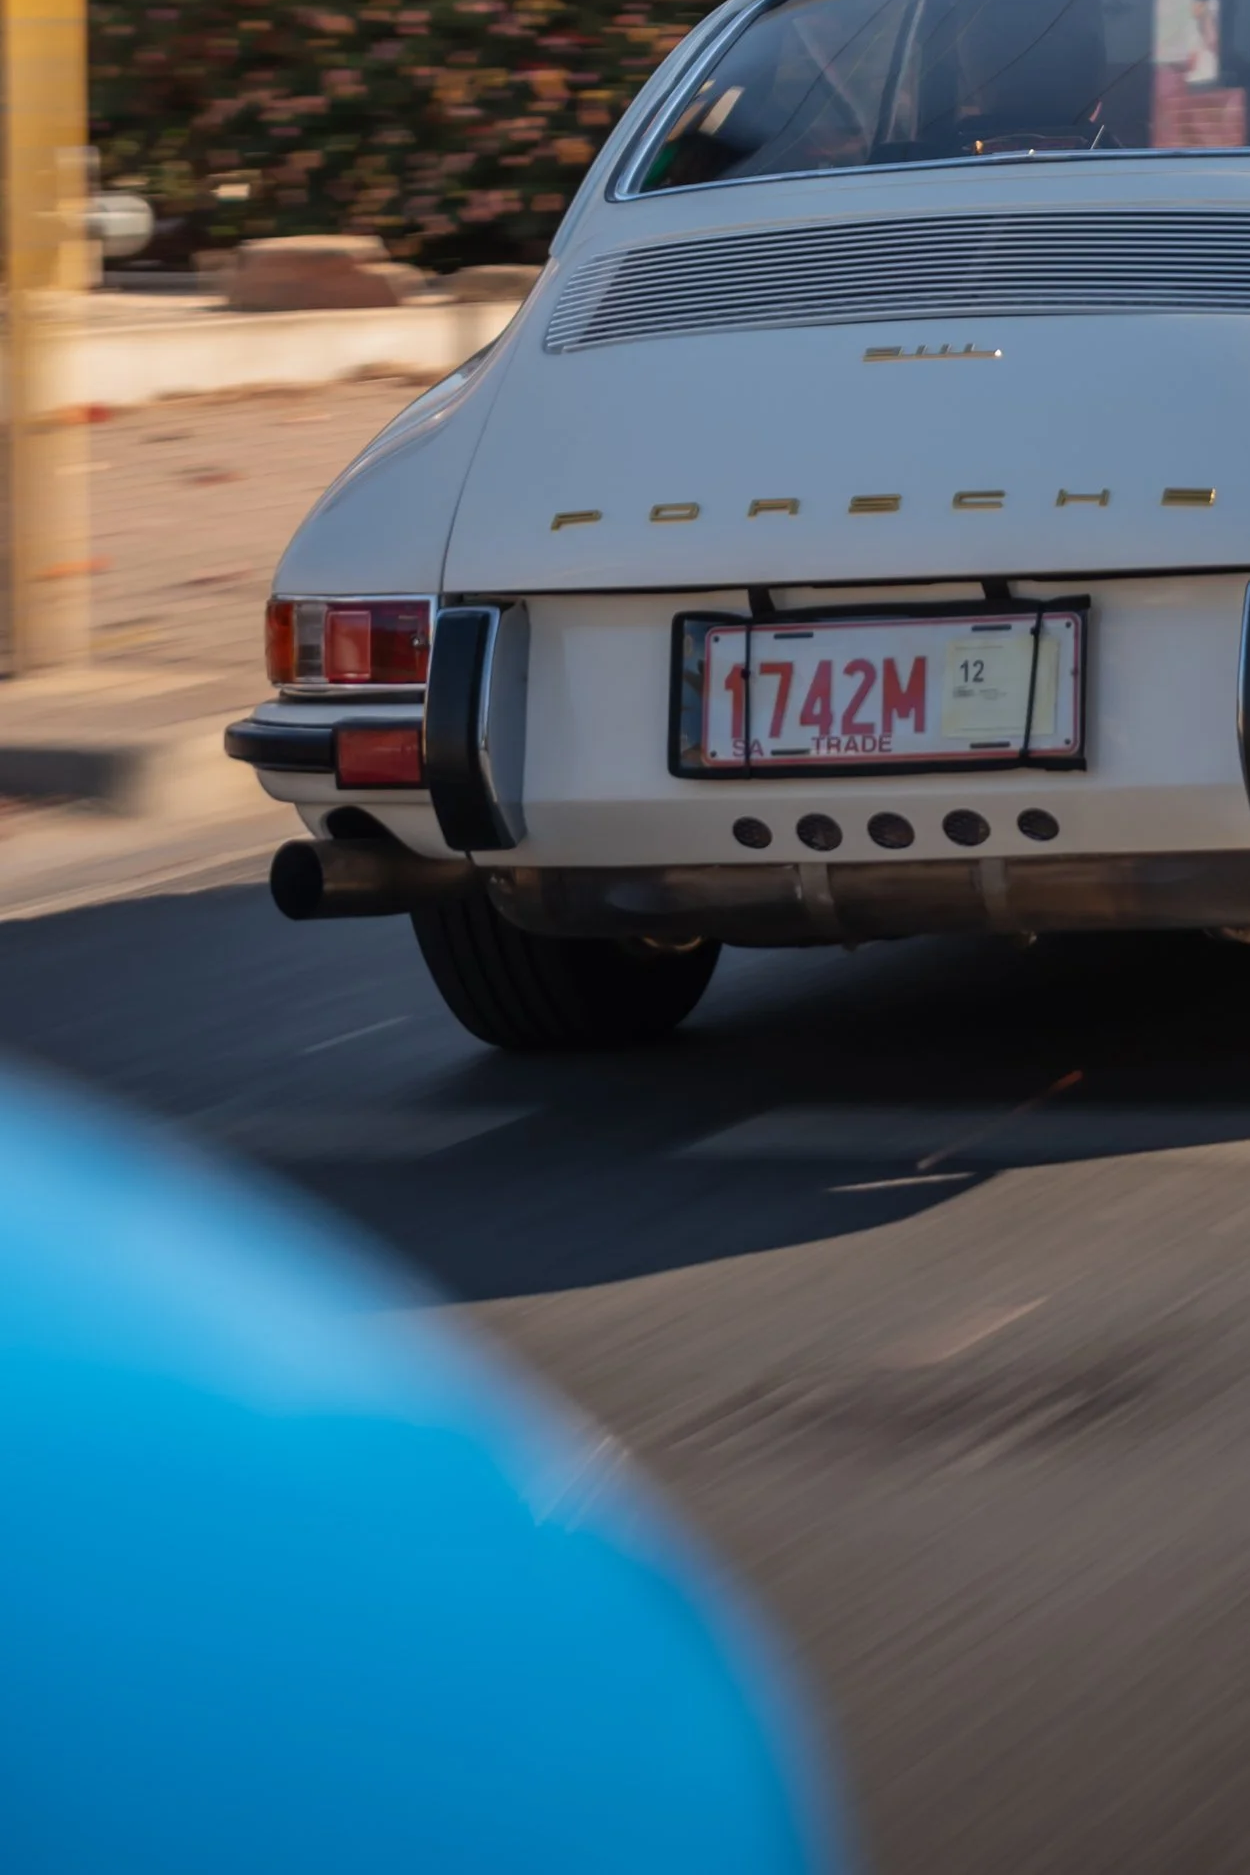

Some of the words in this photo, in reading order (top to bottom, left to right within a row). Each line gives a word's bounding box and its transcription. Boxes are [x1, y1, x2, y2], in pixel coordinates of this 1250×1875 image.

[551, 486, 1217, 531] PORSCHE
[960, 659, 985, 683] 12
[724, 655, 927, 740] 1742M
[812, 733, 893, 755] TRADE
